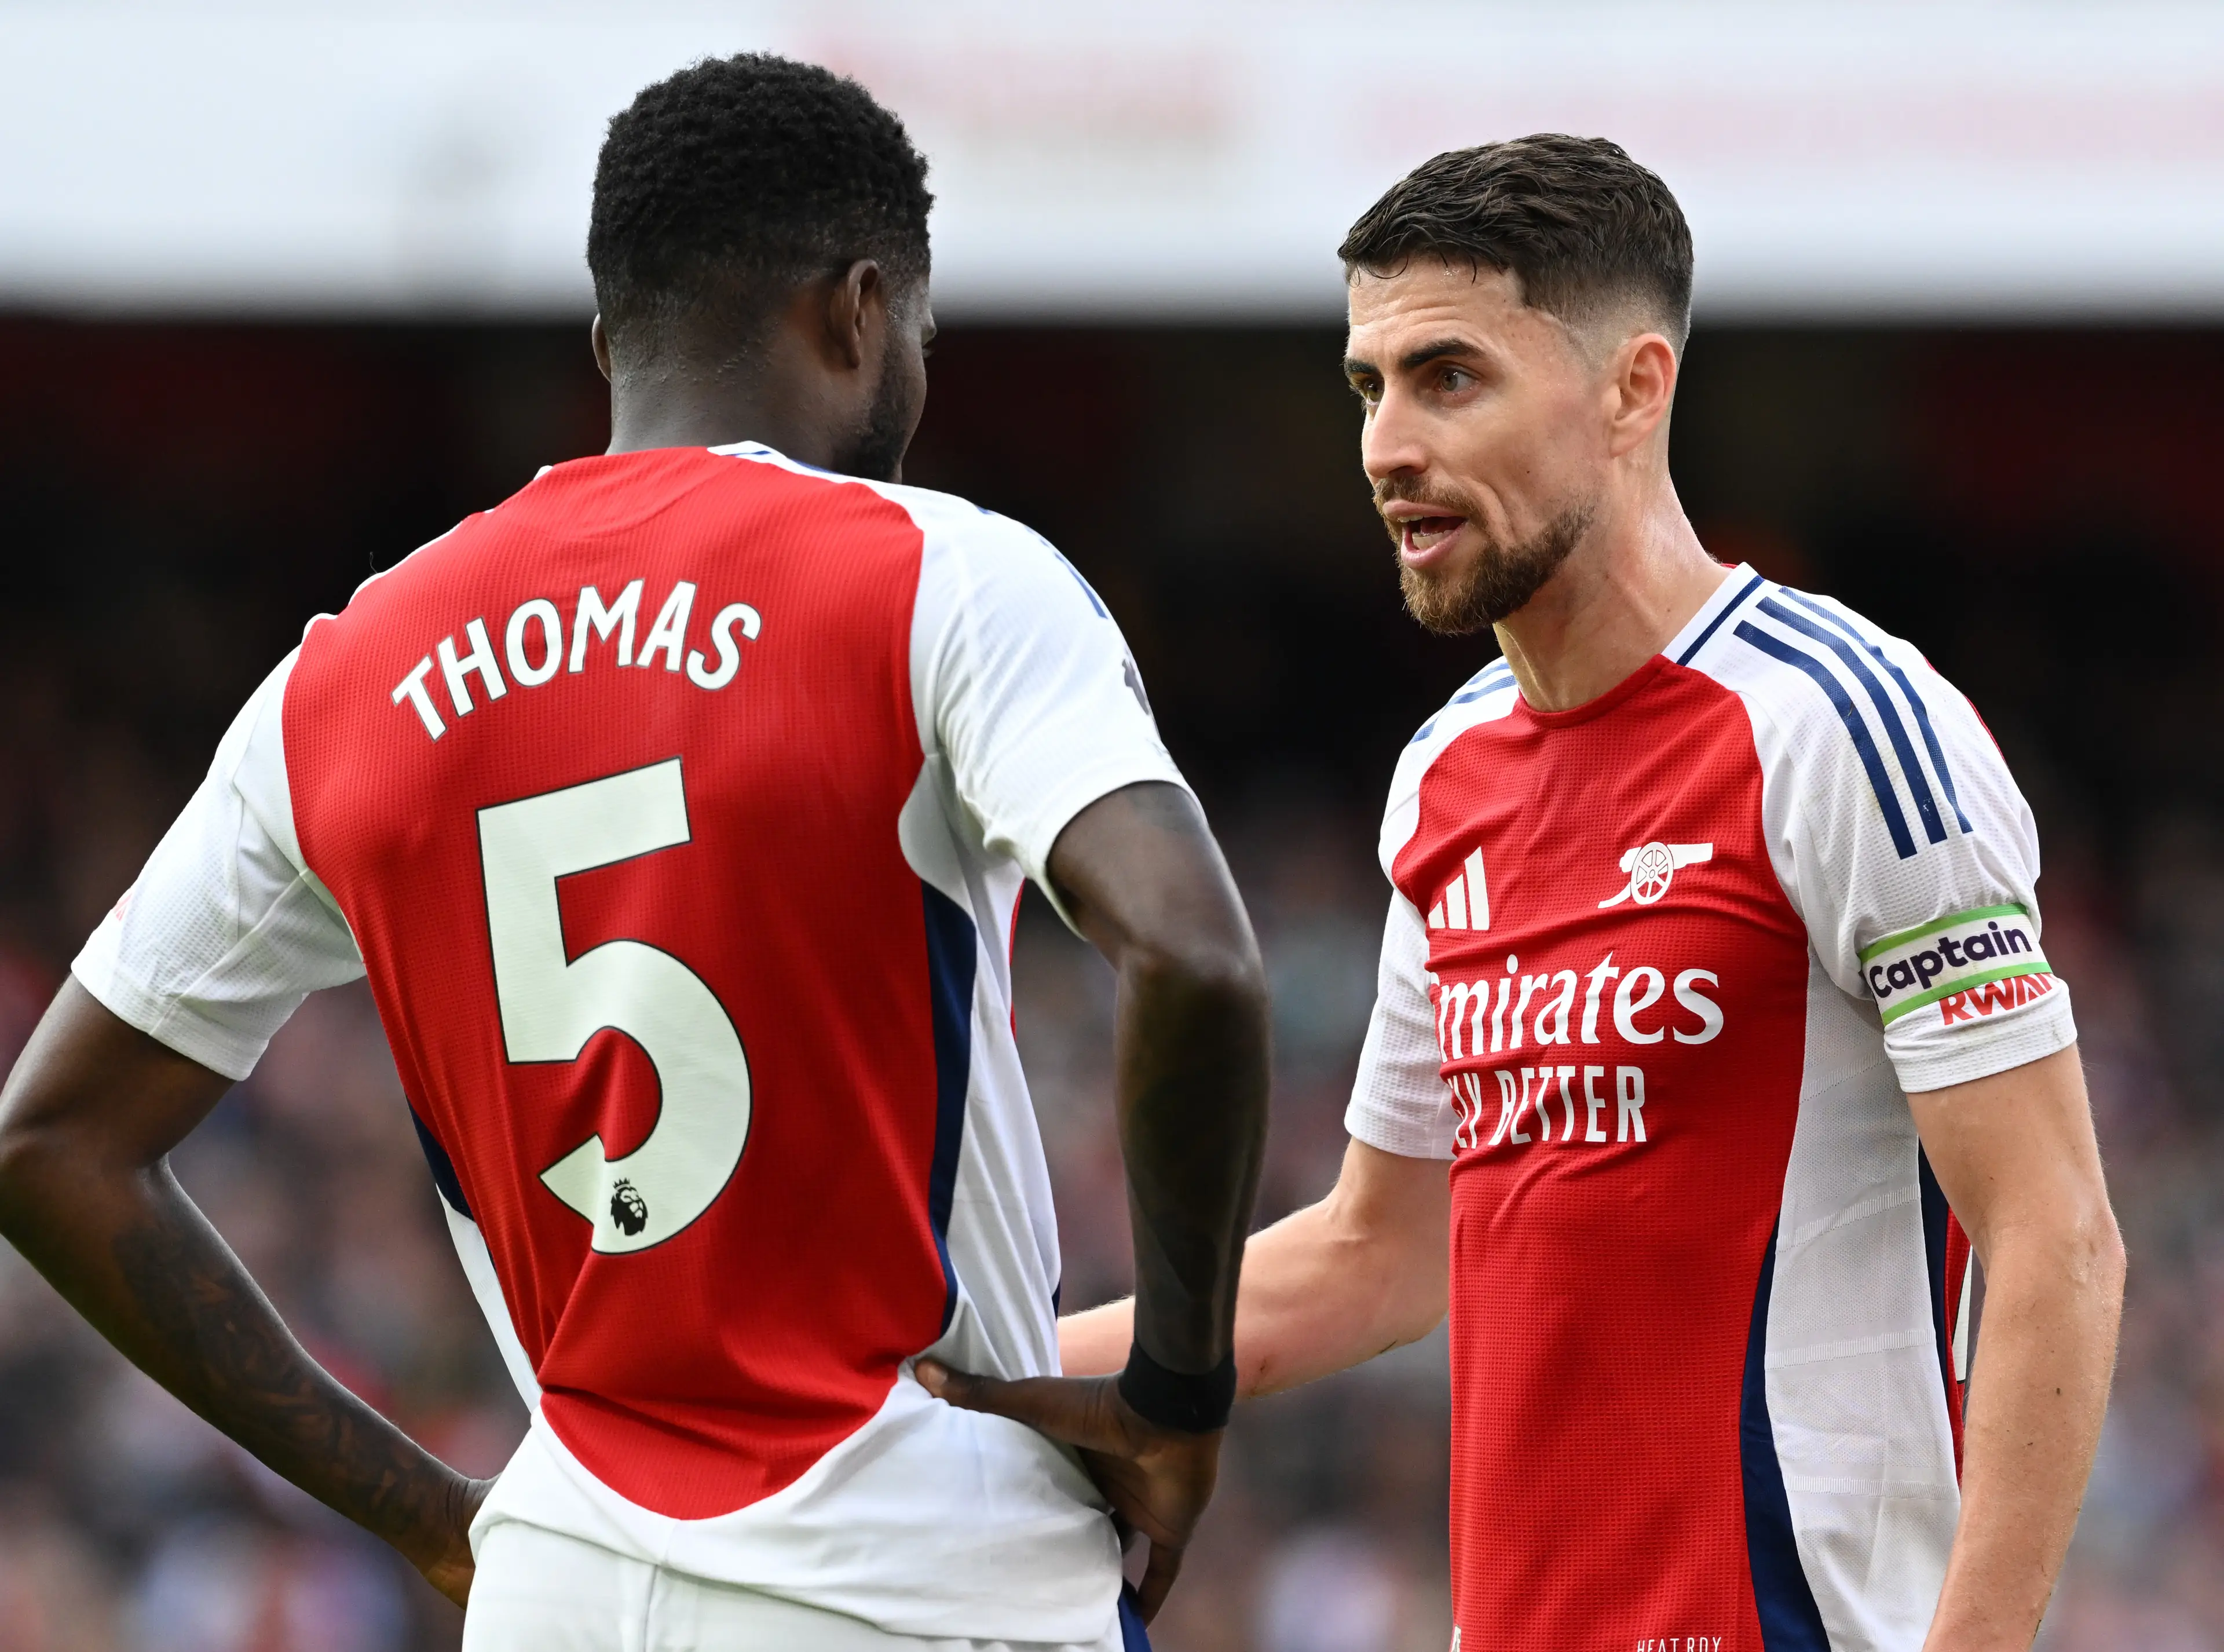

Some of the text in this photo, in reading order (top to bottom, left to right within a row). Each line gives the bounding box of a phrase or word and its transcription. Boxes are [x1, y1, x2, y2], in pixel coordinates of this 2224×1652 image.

[390, 578, 762, 744] THOMAS
[475, 755, 753, 1255] 5
[1429, 948, 1724, 1063] mirates
[1869, 921, 2032, 999] Captain
[1447, 1065, 1648, 1149] LY BETTER
